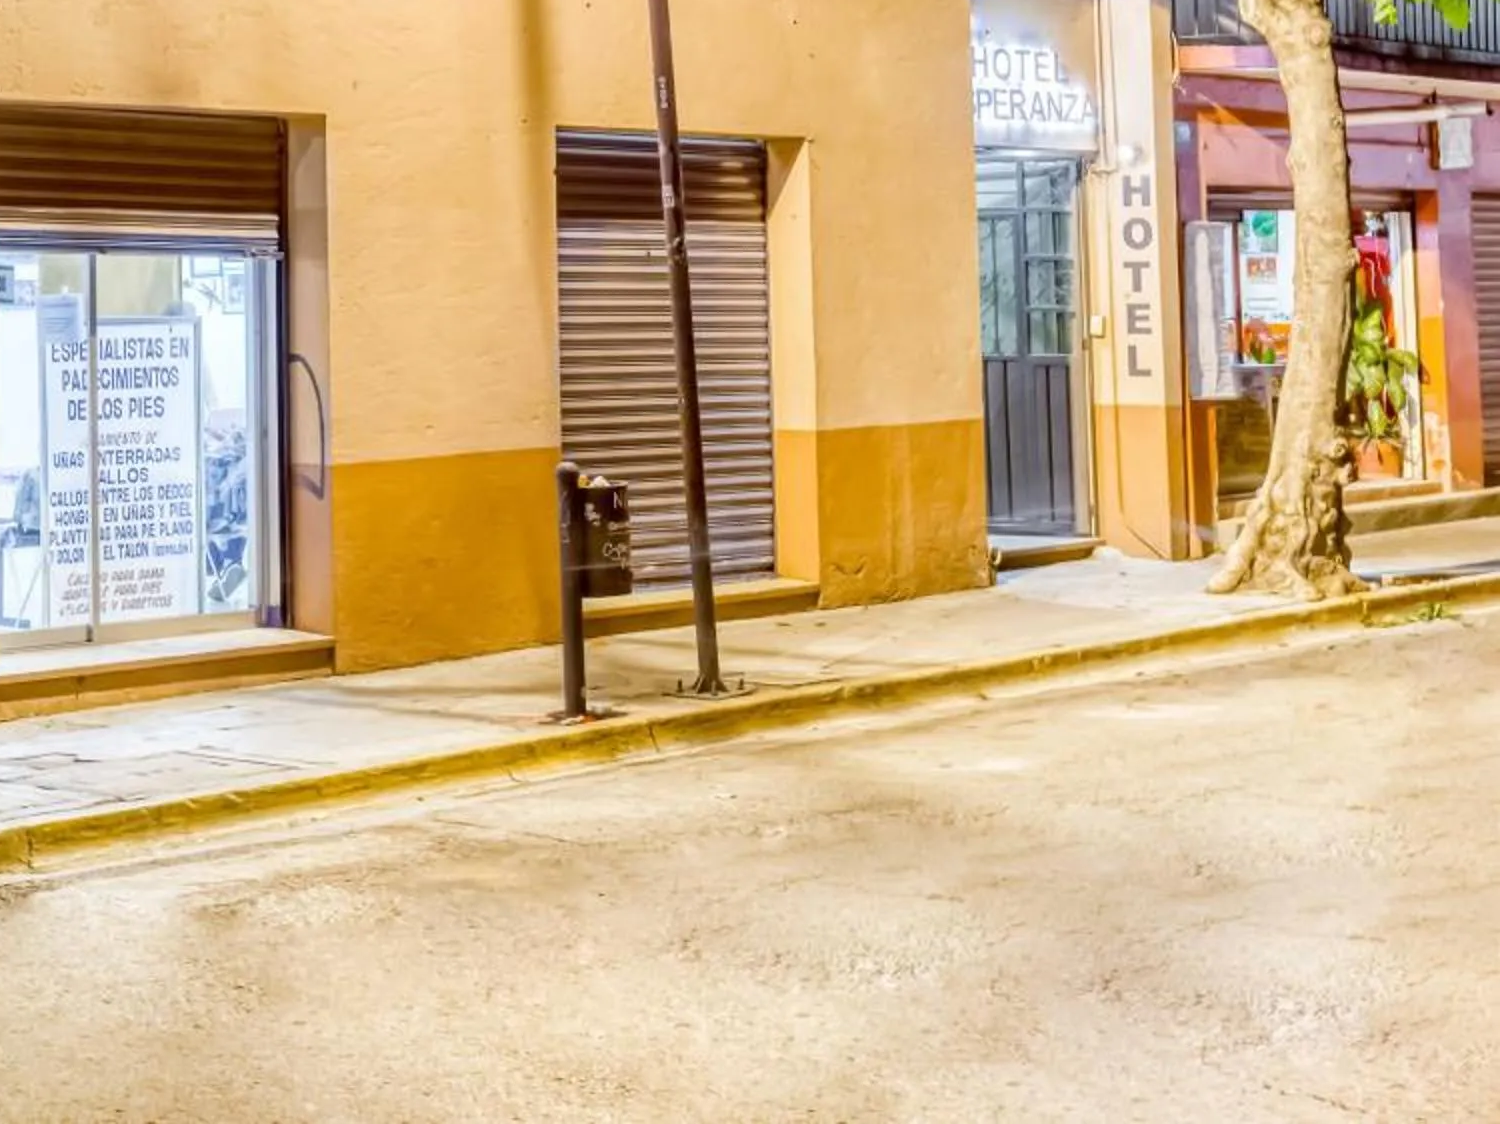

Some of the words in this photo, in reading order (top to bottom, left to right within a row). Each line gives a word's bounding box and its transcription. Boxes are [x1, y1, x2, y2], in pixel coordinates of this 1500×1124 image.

[971, 45, 1069, 84] HOTEL
[972, 87, 1098, 125] PERANZA
[1121, 175, 1154, 377] HOTEL
[51, 337, 164, 363] ESPEIALISTAS
[169, 336, 189, 358] EN
[67, 399, 87, 421] DE
[128, 395, 165, 419] PIES
[96, 446, 181, 466] NTERRADAS
[99, 467, 149, 485] ALLOS
[103, 507, 119, 523] EN
[103, 544, 116, 561] EL
